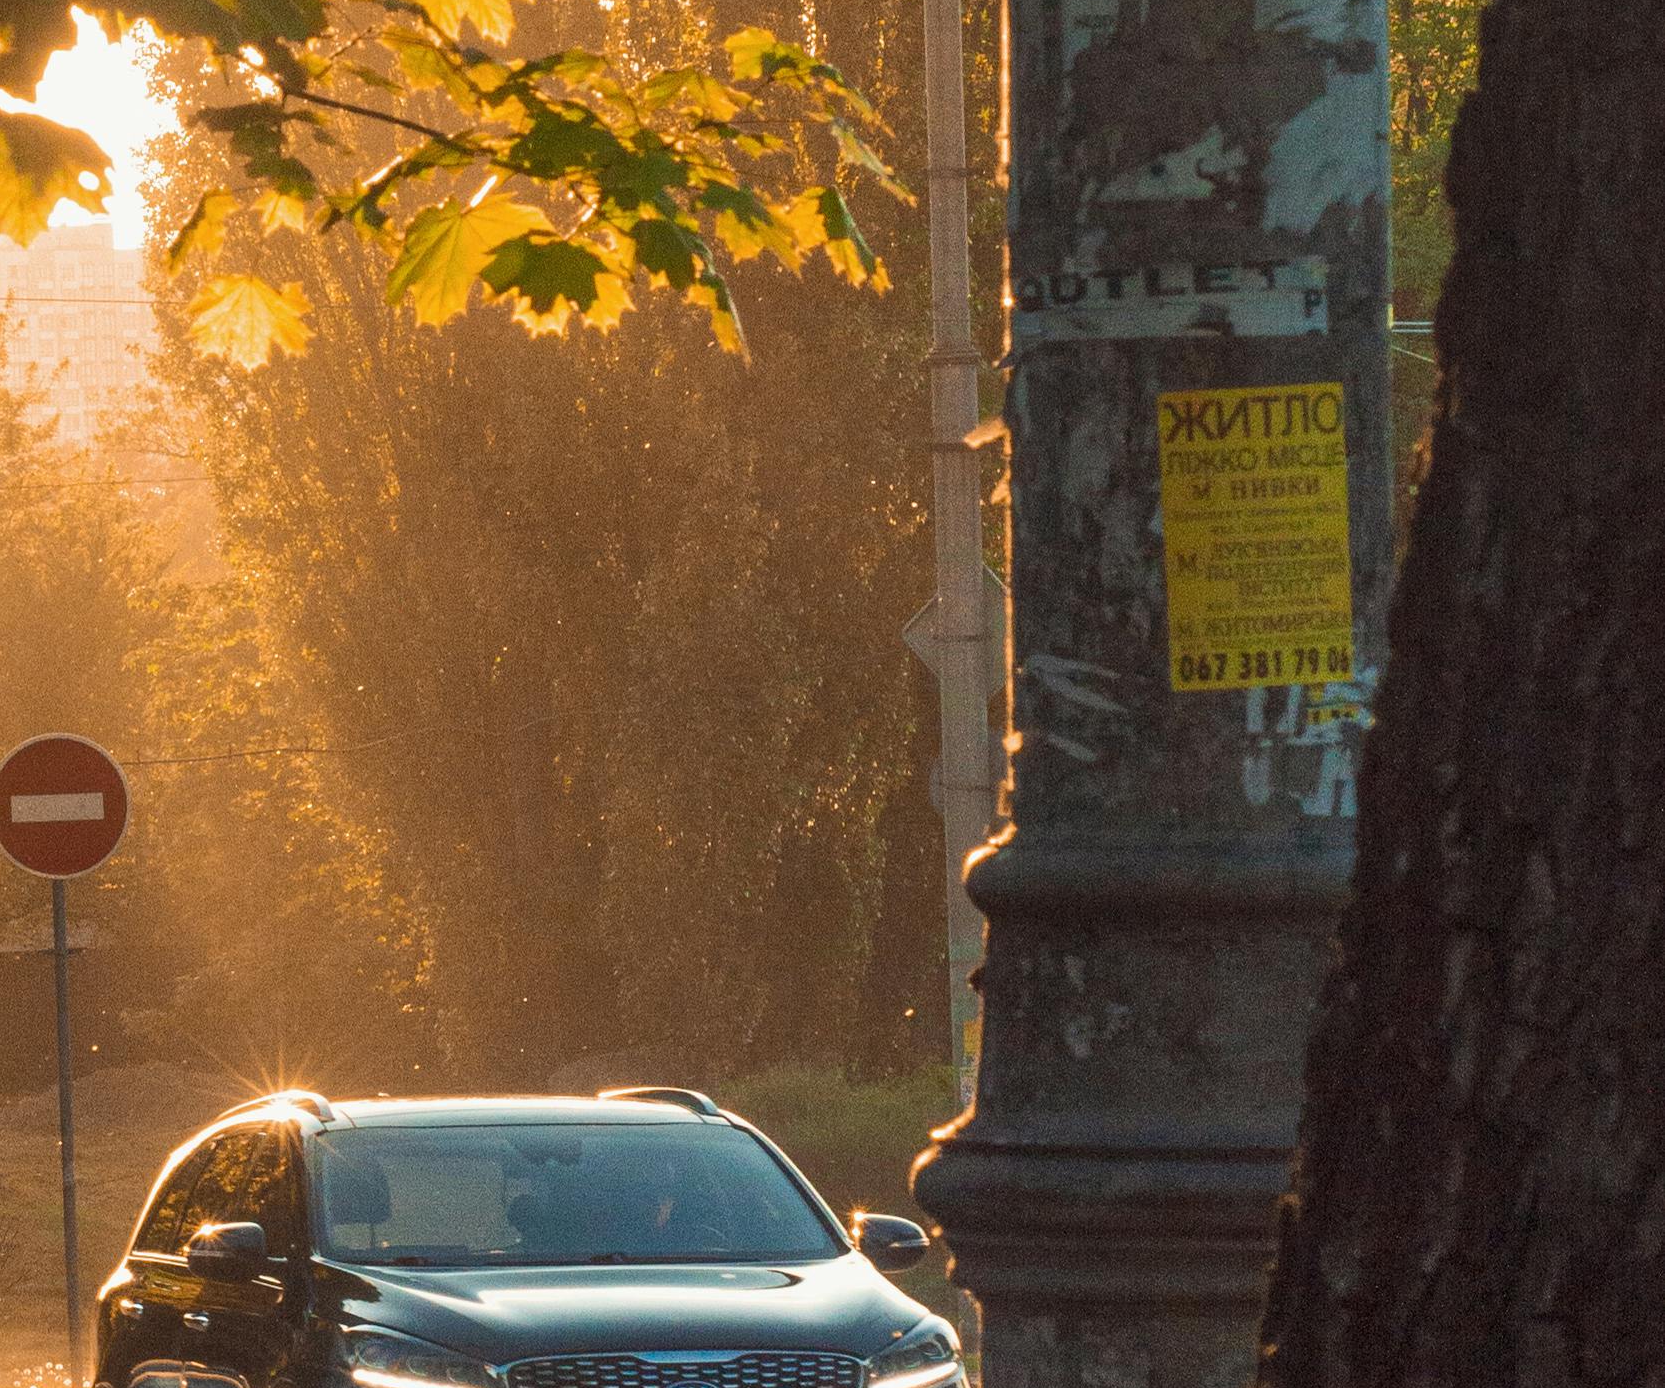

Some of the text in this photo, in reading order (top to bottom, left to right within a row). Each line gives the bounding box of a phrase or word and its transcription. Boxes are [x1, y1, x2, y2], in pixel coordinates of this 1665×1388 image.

[1162, 391, 1342, 443] ЖИТЛО
[1179, 653, 1228, 682] 067
[1238, 649, 1283, 680] 381
[1294, 647, 1320, 676] 79
